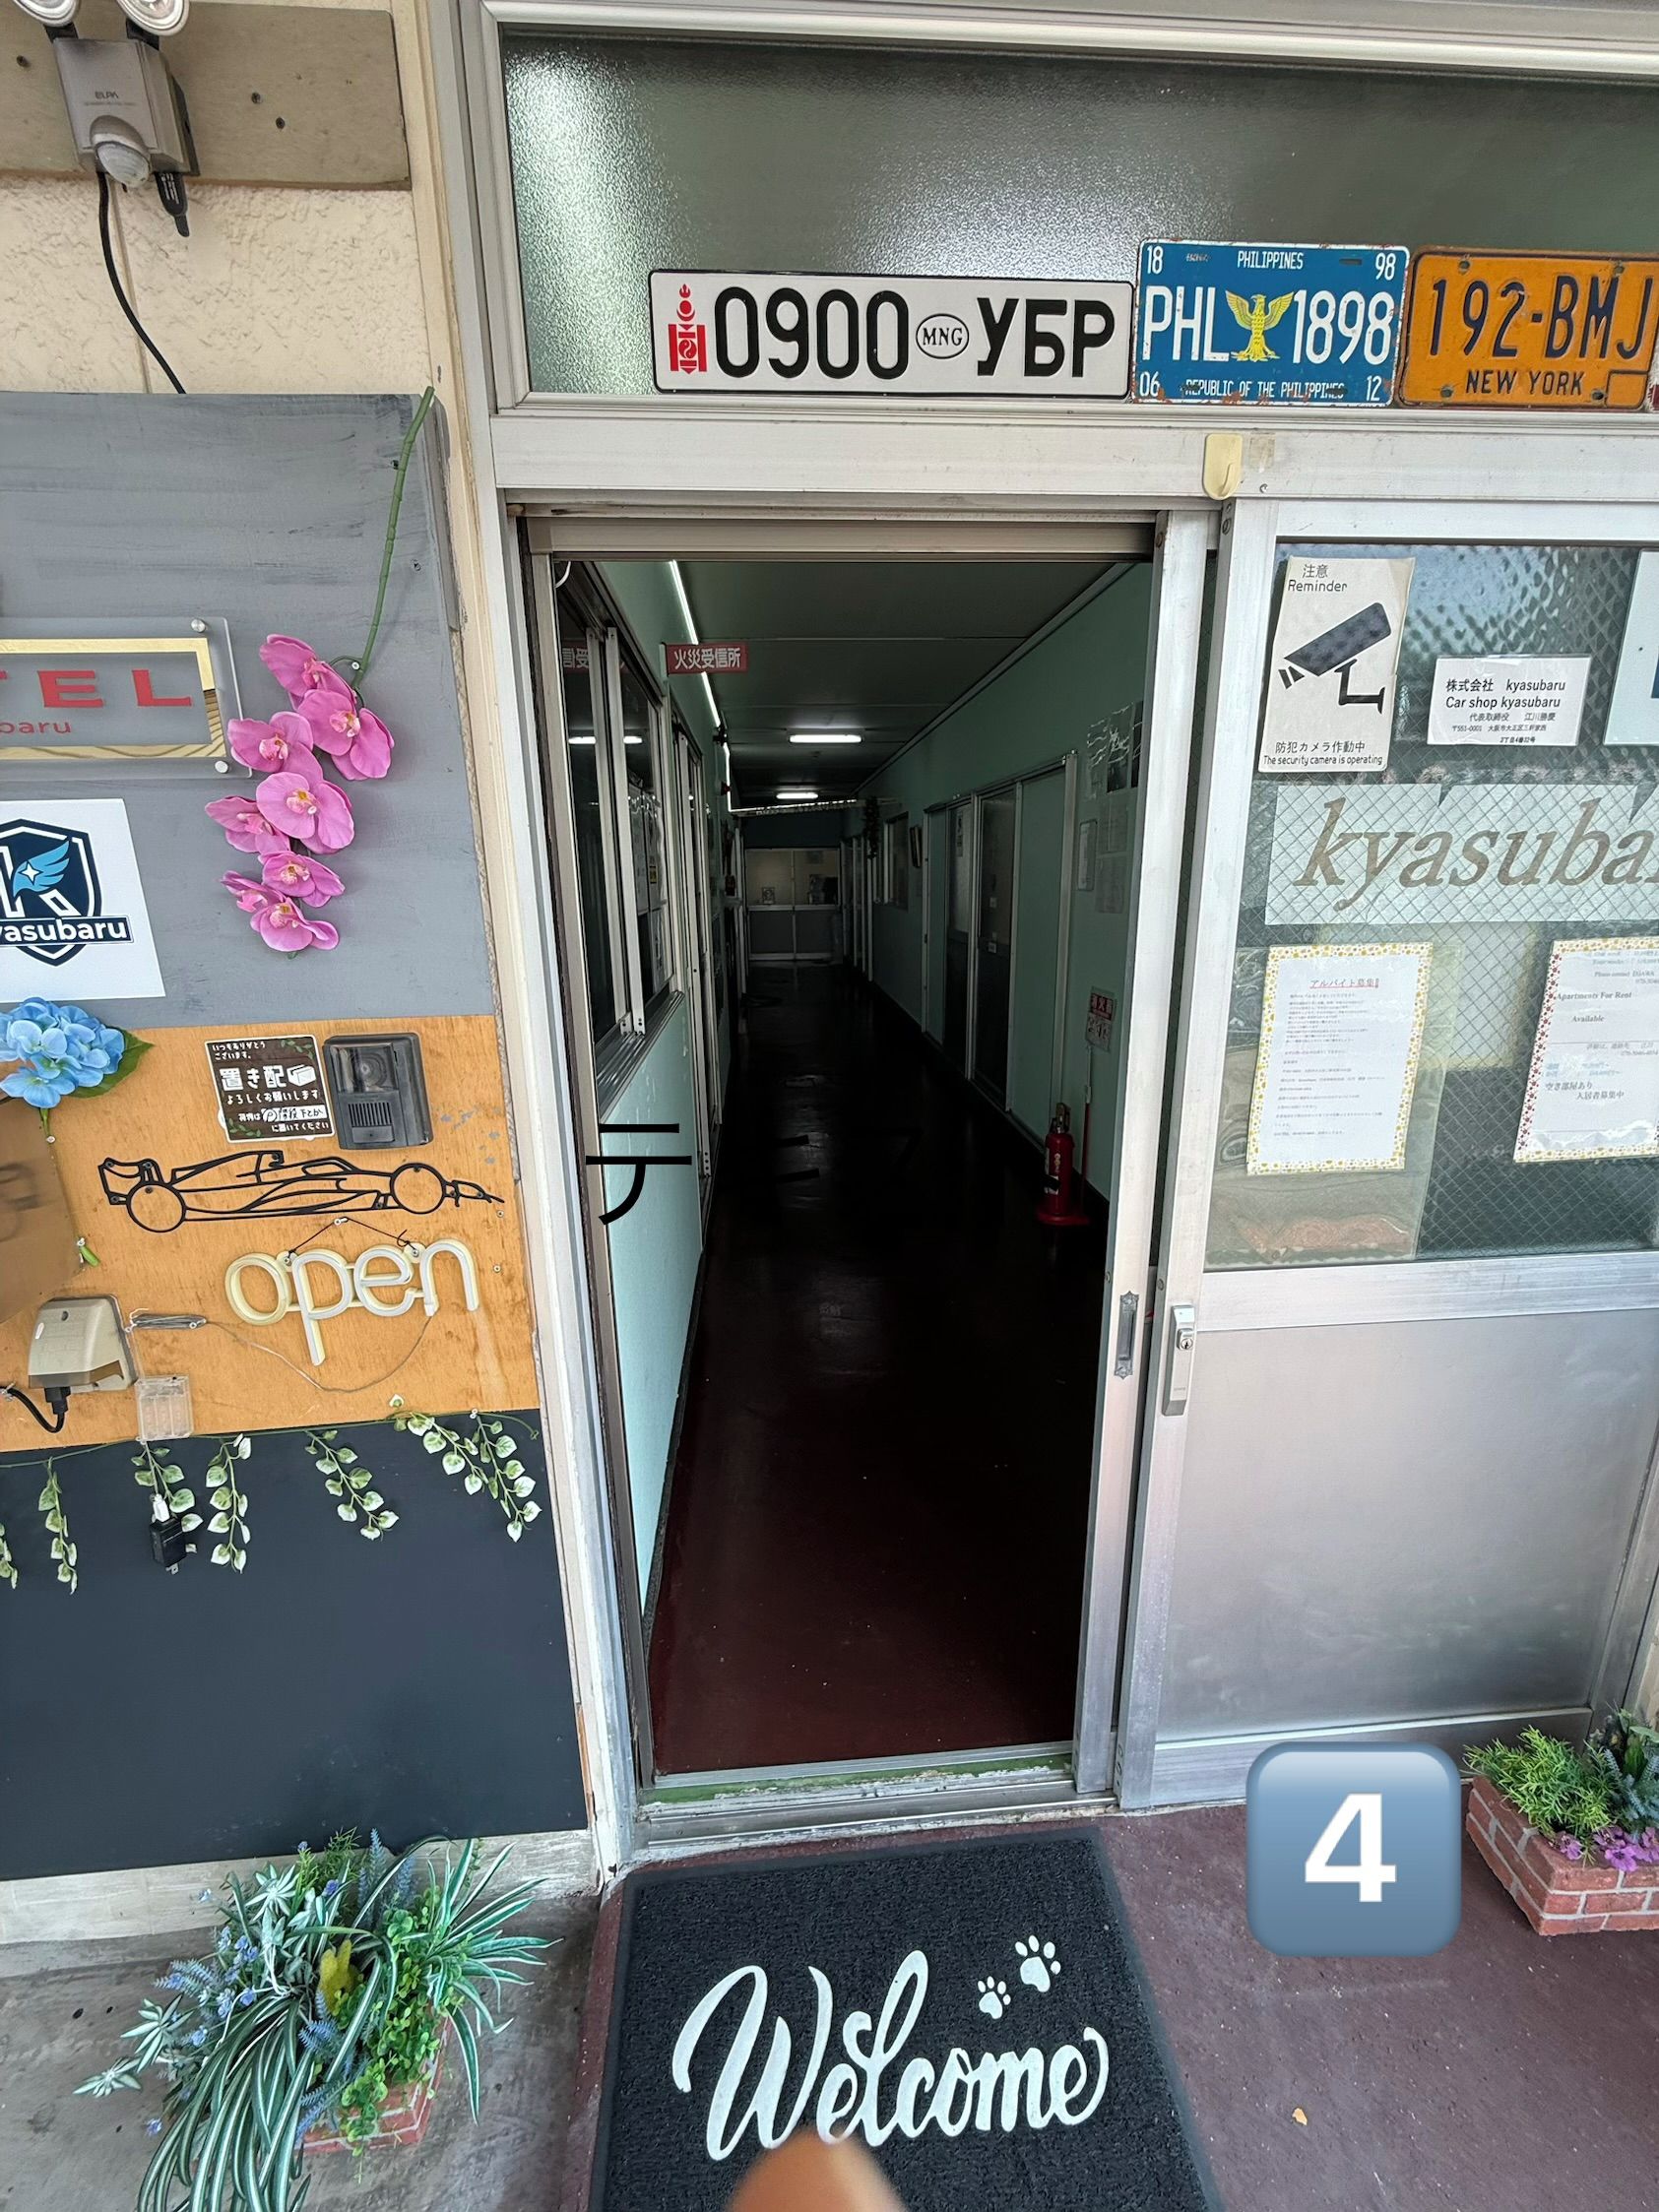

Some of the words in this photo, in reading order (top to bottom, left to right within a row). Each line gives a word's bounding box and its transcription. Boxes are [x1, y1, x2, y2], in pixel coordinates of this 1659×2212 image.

[1146, 244, 1163, 275] 18
[1237, 250, 1304, 270] PHILIPPINES
[1374, 252, 1396, 282] 98
[1142, 284, 1230, 363] PHL
[1292, 288, 1396, 366] 1898
[1430, 275, 1653, 361] 192-BMJ
[714, 286, 909, 380] 0900
[922, 327, 964, 347] MNG
[1139, 370, 1161, 398] 06
[1184, 378, 1235, 397] REPUBLIC
[1239, 380, 1252, 397] OF
[1257, 381, 1276, 399] THE
[1280, 380, 1345, 400] PHILIPPINES
[1366, 375, 1383, 403] 12
[1465, 368, 1517, 395] NEW
[1527, 368, 1584, 396] YORK
[1302, 563, 1329, 580] 注意
[1288, 579, 1349, 594] Reminder
[673, 647, 741, 669] 火災受信所
[0, 668, 193, 709] EL
[1445, 678, 1495, 693] 株式会社
[1505, 678, 1566, 694] kyasubaru
[1445, 696, 1467, 709] Car
[1468, 696, 1499, 710] shop
[1500, 696, 1562, 711] kyasubaru
[1275, 740, 1366, 754] 防犯カメラ作動中
[1263, 754, 1277, 765] The
[1278, 754, 1308, 767] security
[1309, 755, 1337, 765] camera
[1338, 754, 1346, 765] is
[1346, 754, 1383, 766] operating
[0, 919, 128, 942] asubaru
[1557, 993, 1598, 1002] Apartments
[219, 1065, 287, 1092] 置き配
[1545, 1081, 1593, 1091] 空き部屋あり
[226, 1089, 320, 1106] よろしくお願いします
[1576, 1090, 1625, 1101] 入居者募集中
[271, 1121, 330, 1133] に置いてください
[224, 1237, 480, 1366] open
[671, 1949, 1110, 2162] Welcome
